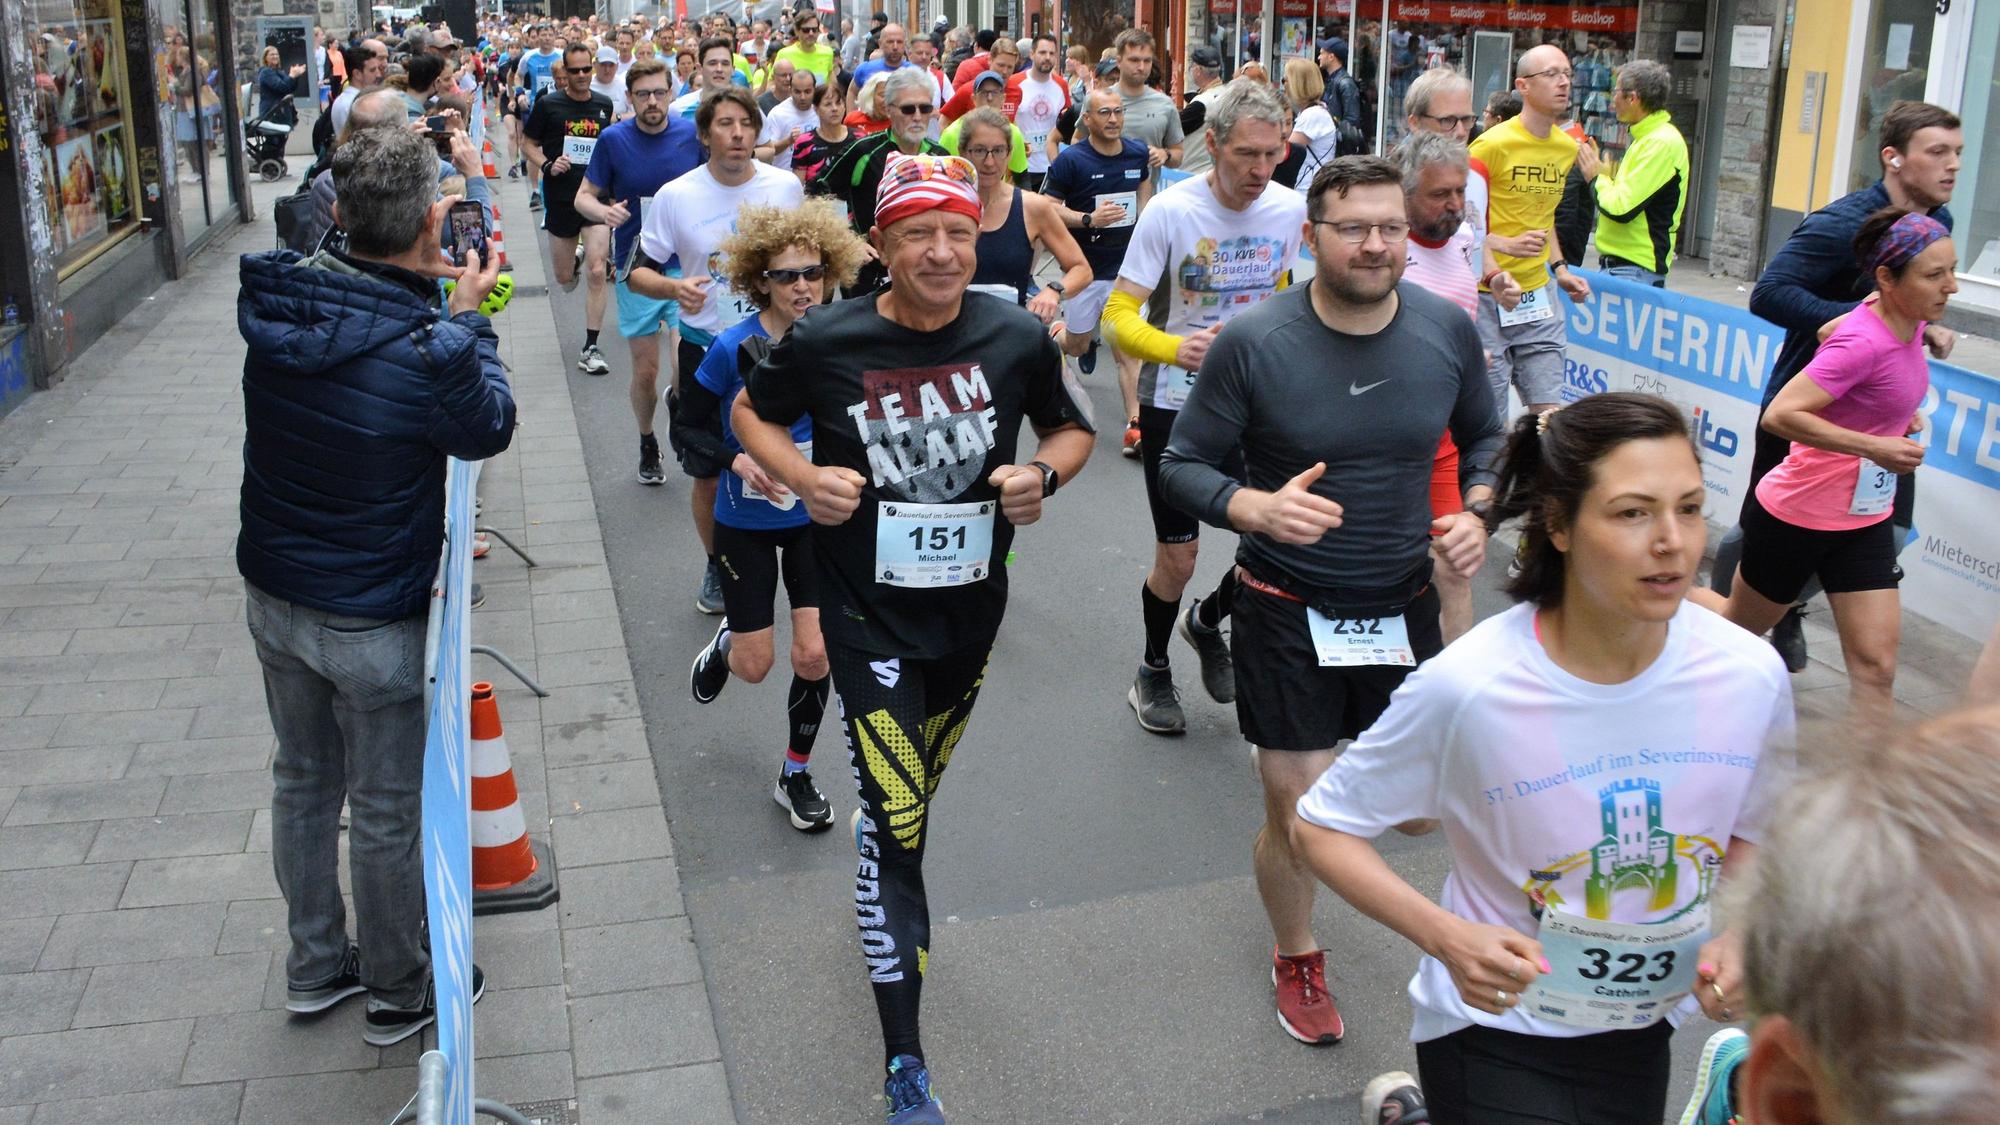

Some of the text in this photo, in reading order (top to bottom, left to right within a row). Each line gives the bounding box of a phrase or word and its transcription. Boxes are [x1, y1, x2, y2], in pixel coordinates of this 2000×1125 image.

[565, 116, 600, 136] Köln
[572, 143, 592, 153] 398
[1212, 248, 1256, 263] 30. KVB
[1212, 261, 1272, 275] Dauerlauf
[847, 365, 993, 445] TEAM
[866, 406, 999, 488] ALAAF
[896, 511, 932, 520] Dauerlauf
[908, 525, 966, 551] 151
[918, 553, 957, 562] Michael
[1333, 618, 1383, 635] 232
[1484, 788, 1513, 806] 37.
[1514, 755, 1605, 798] Dauerlauf
[1610, 753, 1633, 770] im
[1550, 921, 1567, 932] 37.
[1569, 925, 1625, 942] Dauerlauf
[1577, 947, 1677, 983] 323
[1594, 985, 1650, 997] Cathrin
